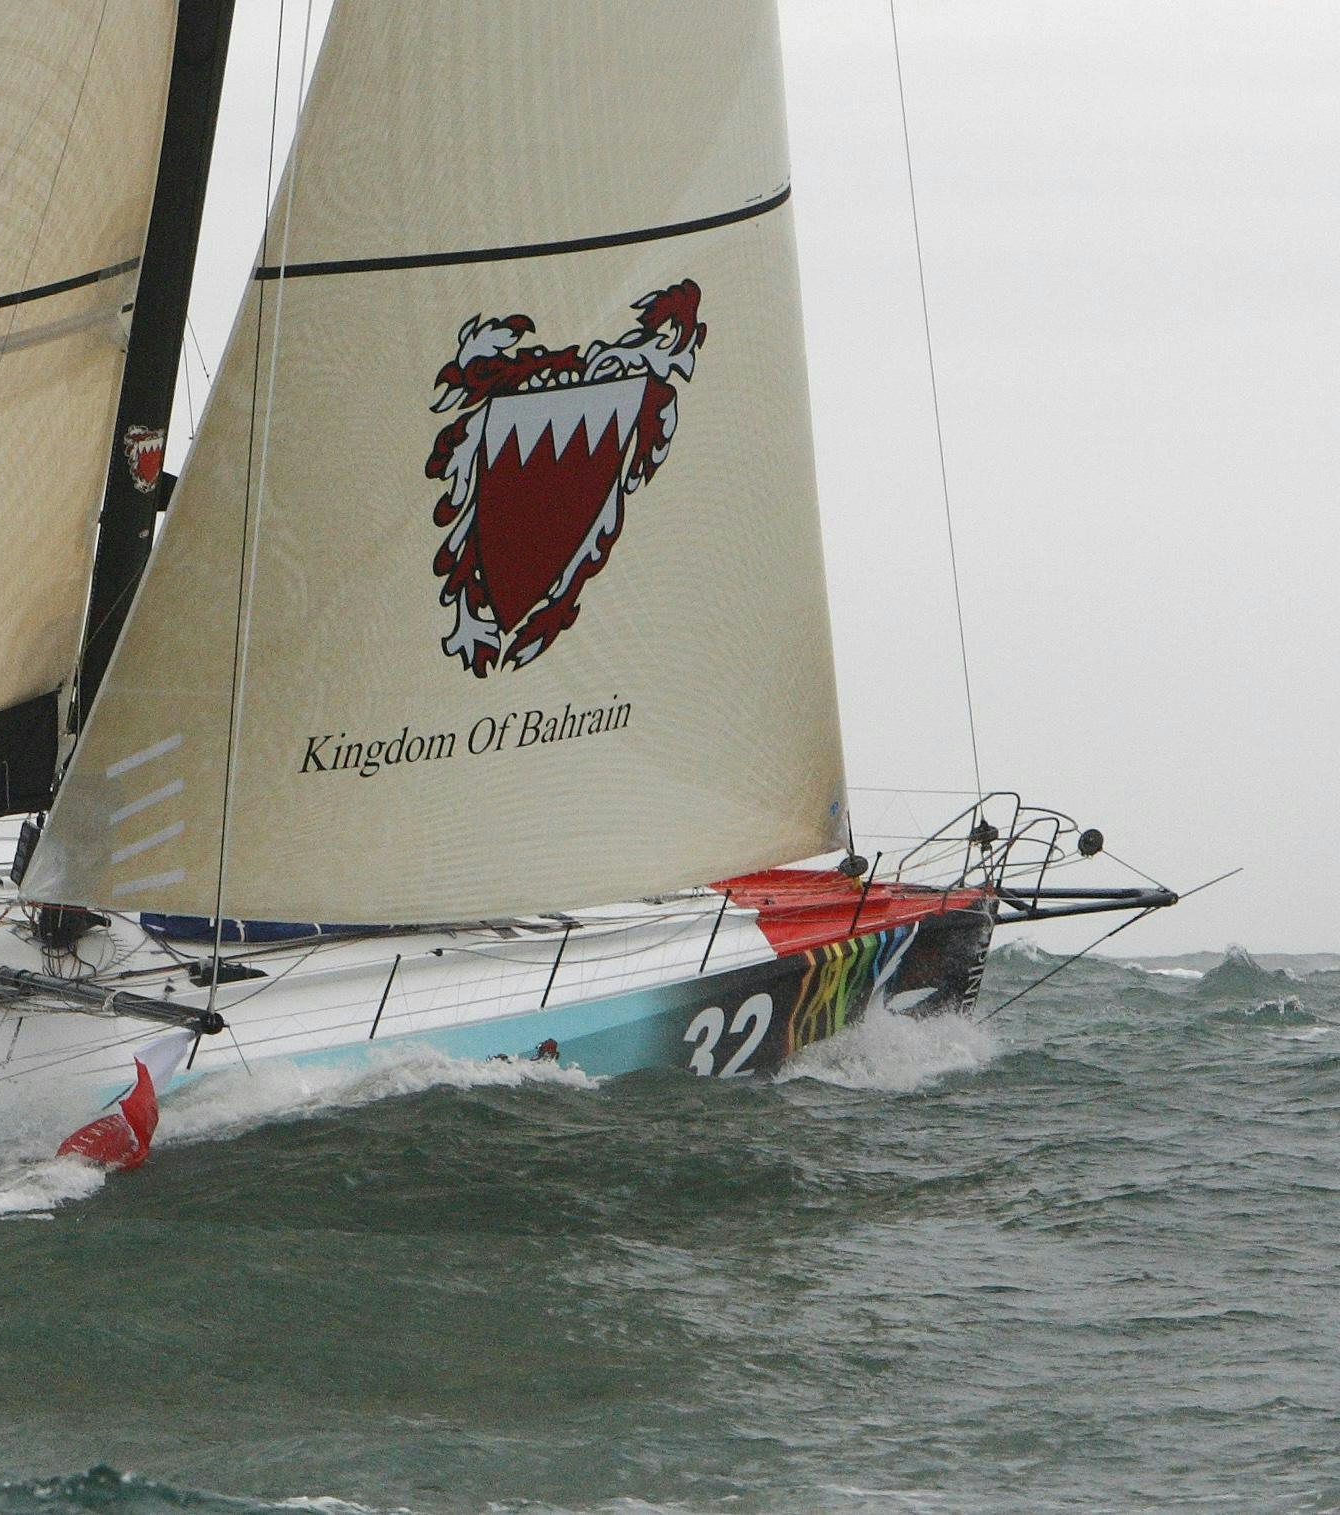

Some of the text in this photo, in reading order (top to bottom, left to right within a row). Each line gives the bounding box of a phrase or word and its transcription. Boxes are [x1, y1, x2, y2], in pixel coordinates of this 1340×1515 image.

[298, 693, 633, 778] Kingdom Of Bahrain
[682, 992, 774, 1080] 32
